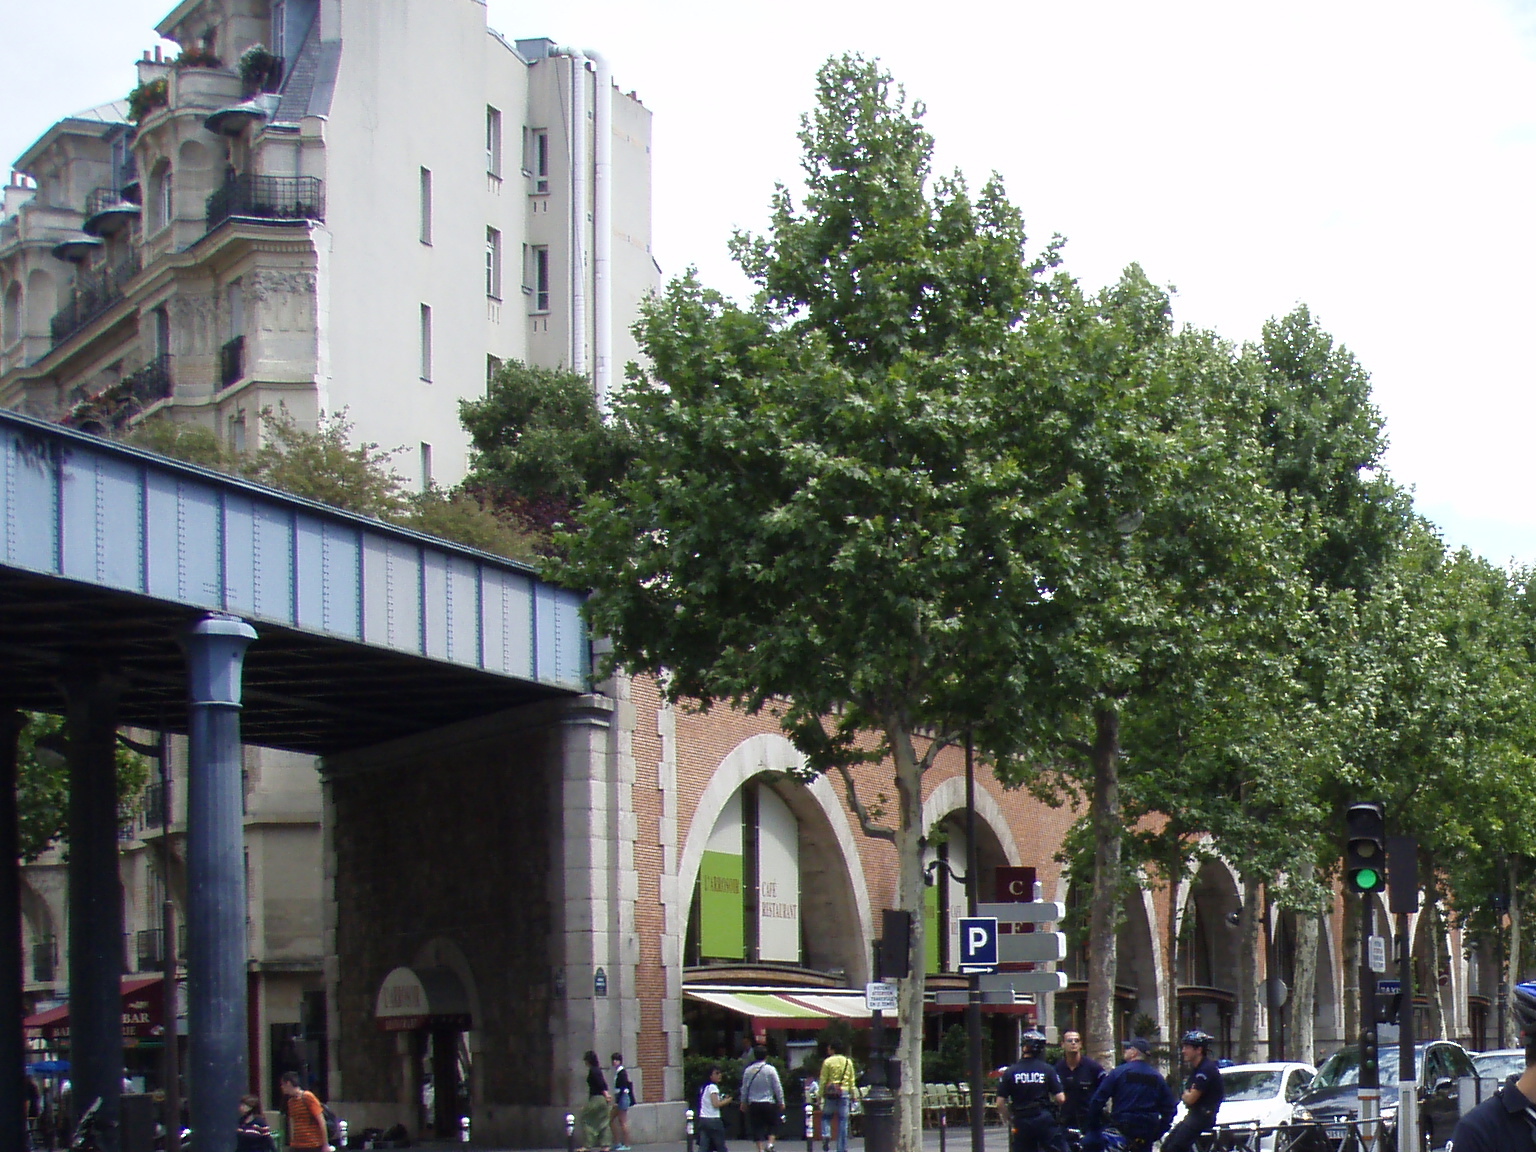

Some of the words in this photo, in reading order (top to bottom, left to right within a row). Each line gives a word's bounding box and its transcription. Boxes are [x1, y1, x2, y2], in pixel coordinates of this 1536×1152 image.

[761, 902, 797, 919] RESTAURANT
[969, 927, 987, 955] P
[122, 1013, 149, 1024] BAR
[1014, 1072, 1045, 1084] POLICE
